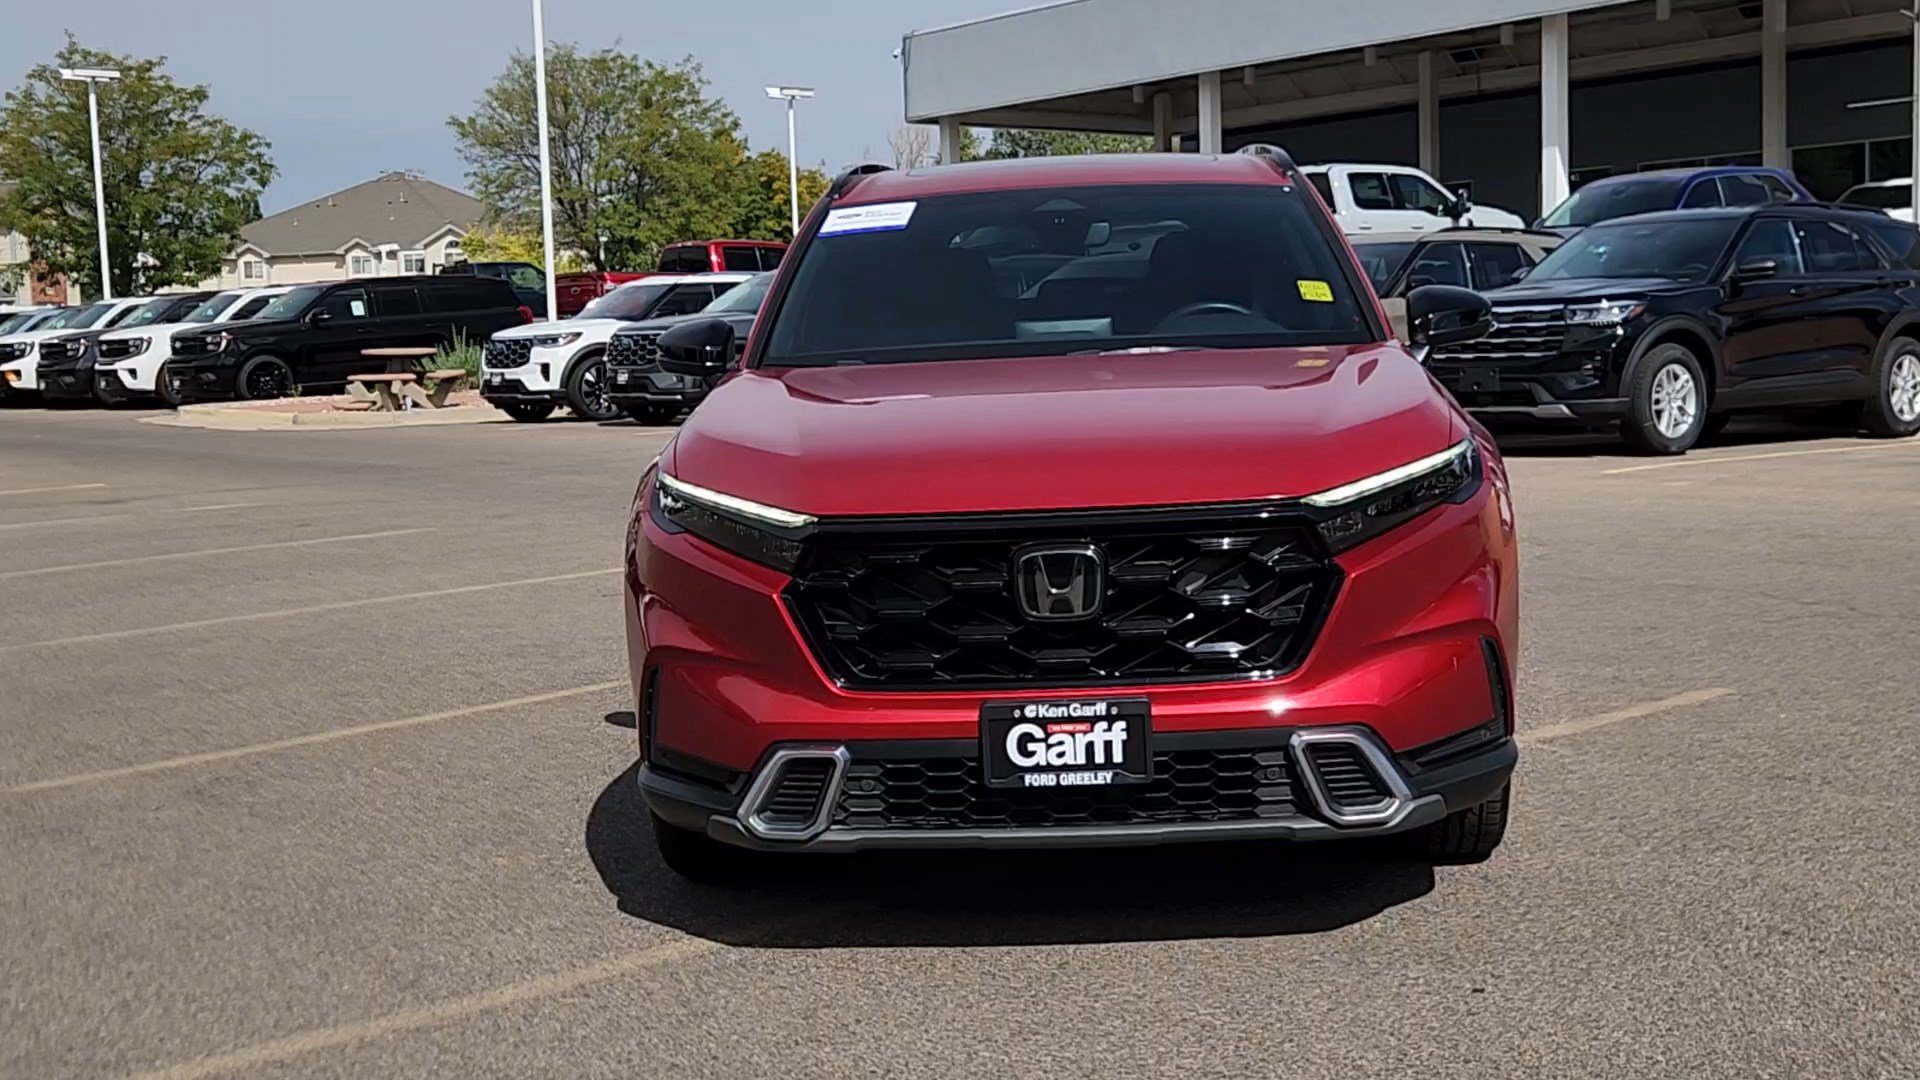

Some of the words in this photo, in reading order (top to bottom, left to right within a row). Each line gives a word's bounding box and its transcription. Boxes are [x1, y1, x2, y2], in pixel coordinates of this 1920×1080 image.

[1038, 703, 1068, 718] Ken
[1069, 702, 1107, 717] Garff
[1006, 721, 1127, 767] Garff
[1024, 774, 1057, 787] FORD
[1059, 772, 1113, 785] GREELEY
